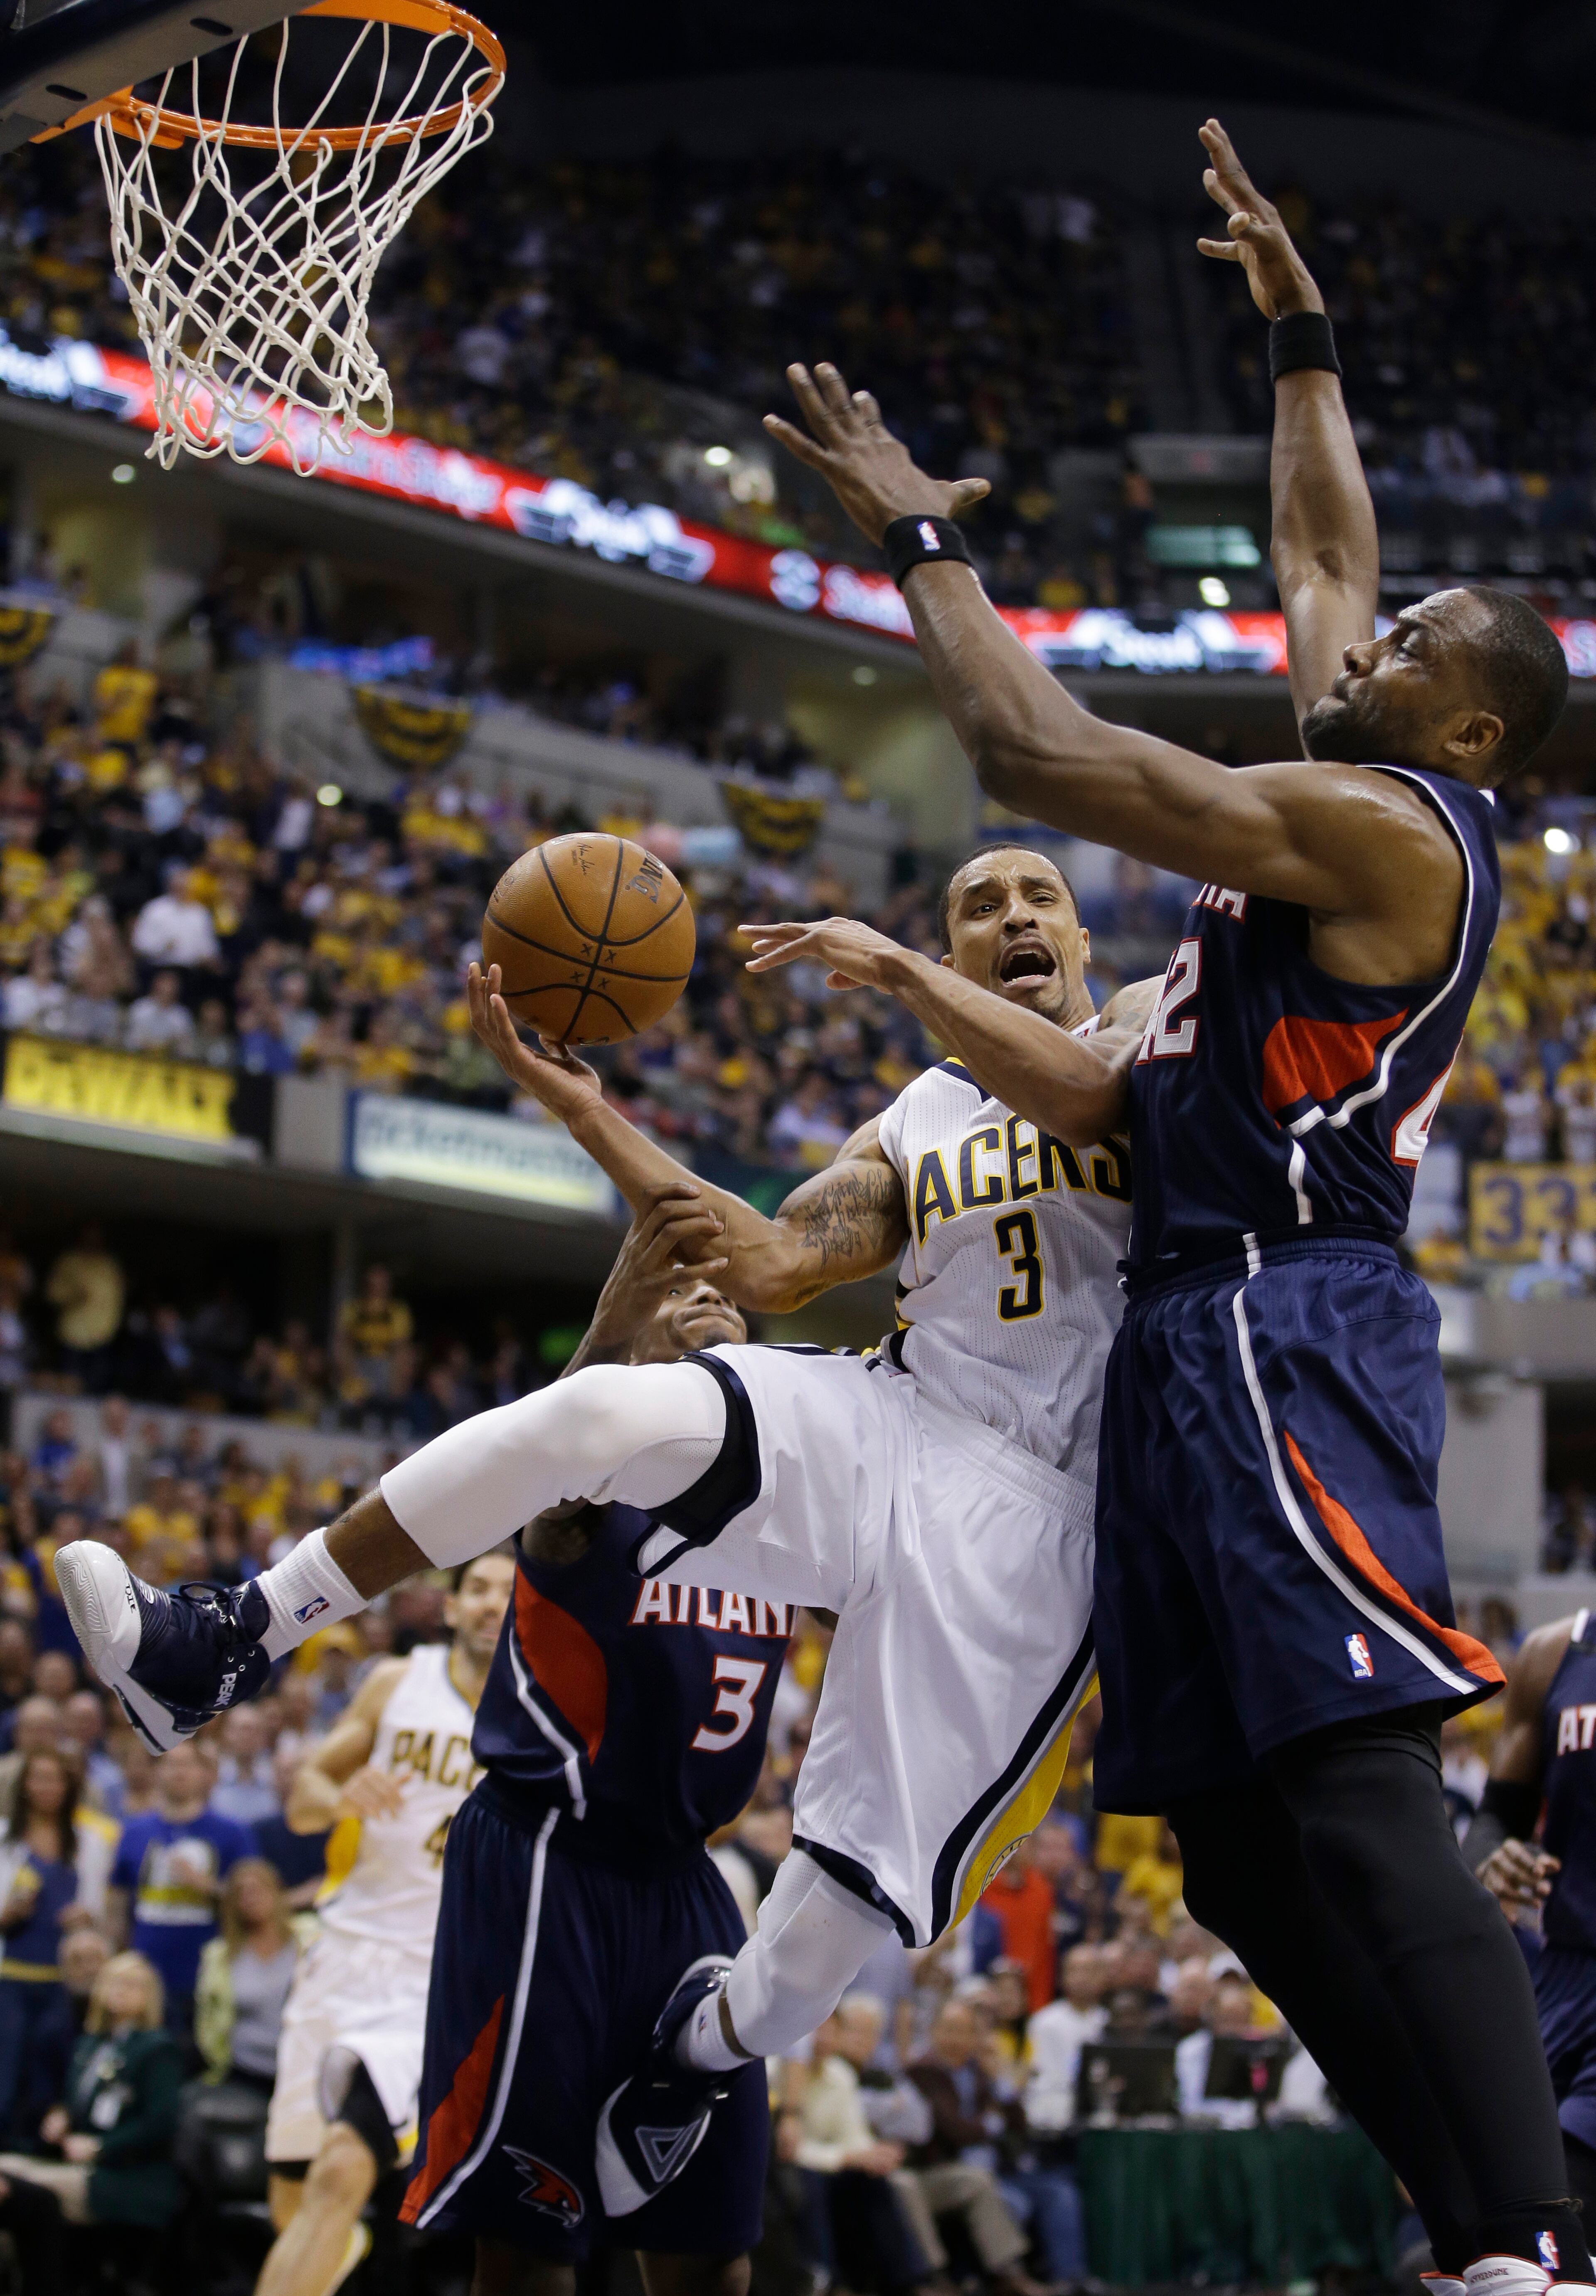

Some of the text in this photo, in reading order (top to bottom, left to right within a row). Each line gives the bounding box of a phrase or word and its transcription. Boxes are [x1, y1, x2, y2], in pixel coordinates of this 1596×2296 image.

[910, 1113, 1133, 1249] ACERS
[993, 1207, 1044, 1323] 3
[628, 1579, 799, 1640] ATLAN
[213, 1672, 237, 1707] PEAK
[689, 1655, 767, 1754] 3
